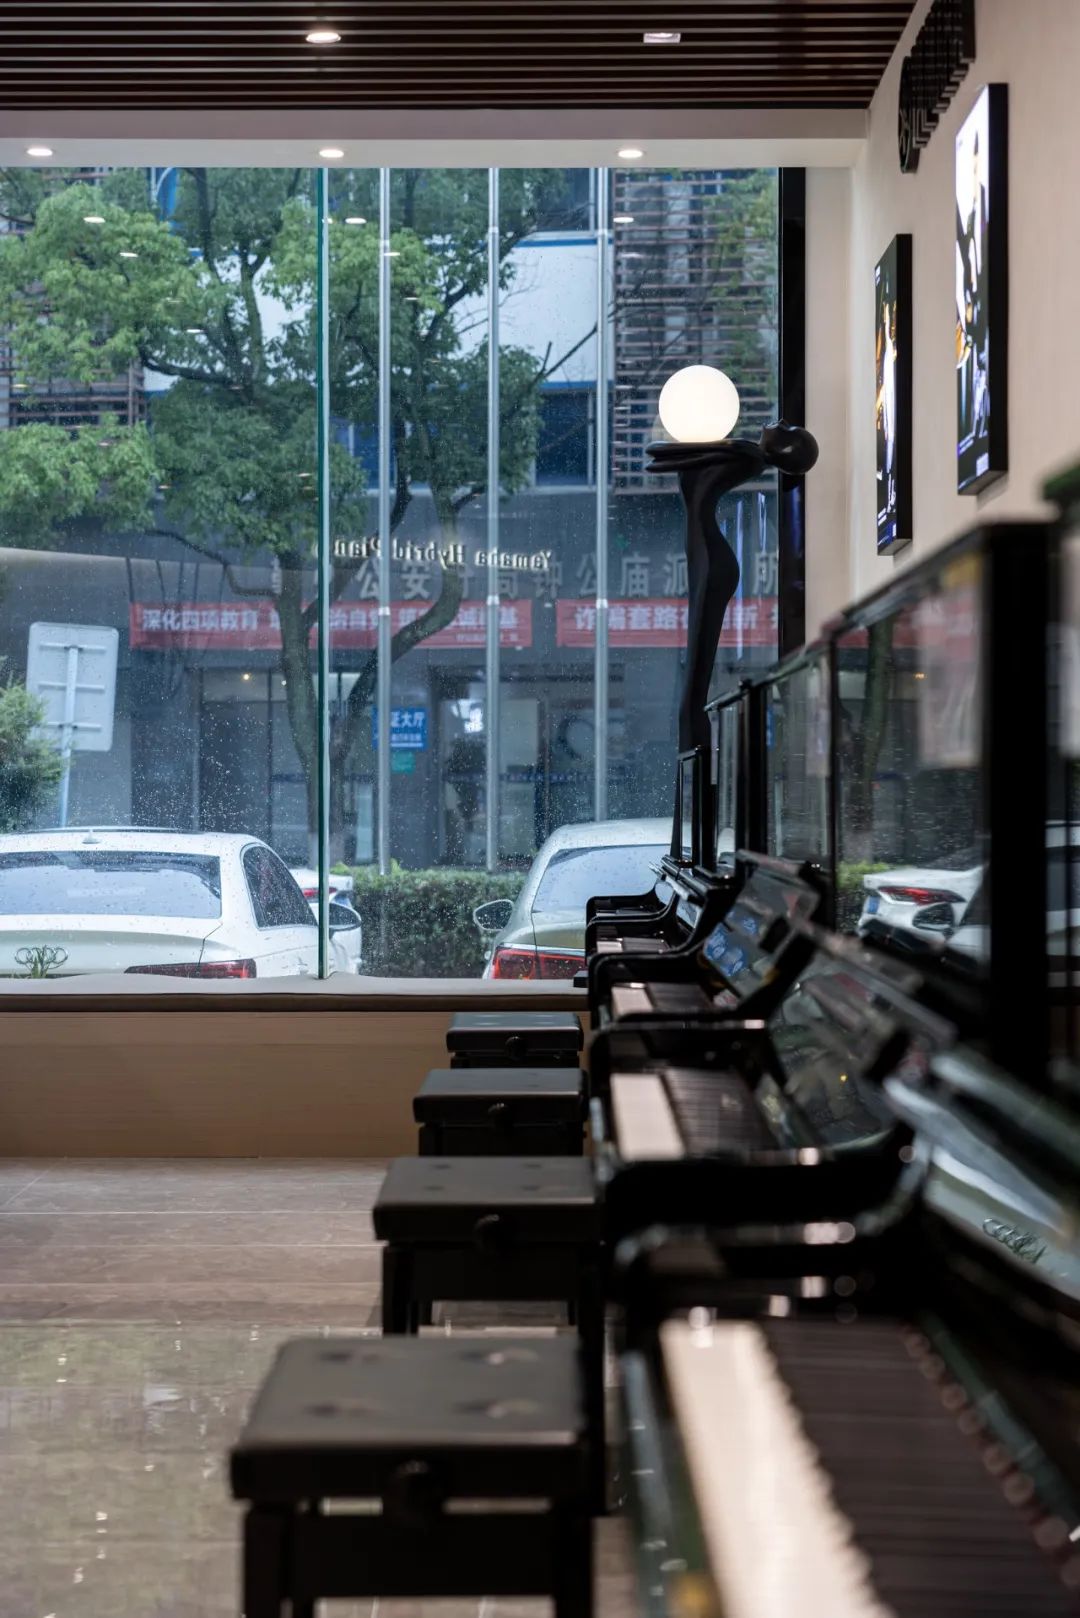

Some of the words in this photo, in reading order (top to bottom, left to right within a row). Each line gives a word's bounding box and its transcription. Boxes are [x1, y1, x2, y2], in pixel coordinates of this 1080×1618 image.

[143, 608, 258, 631] 深化四项教育
